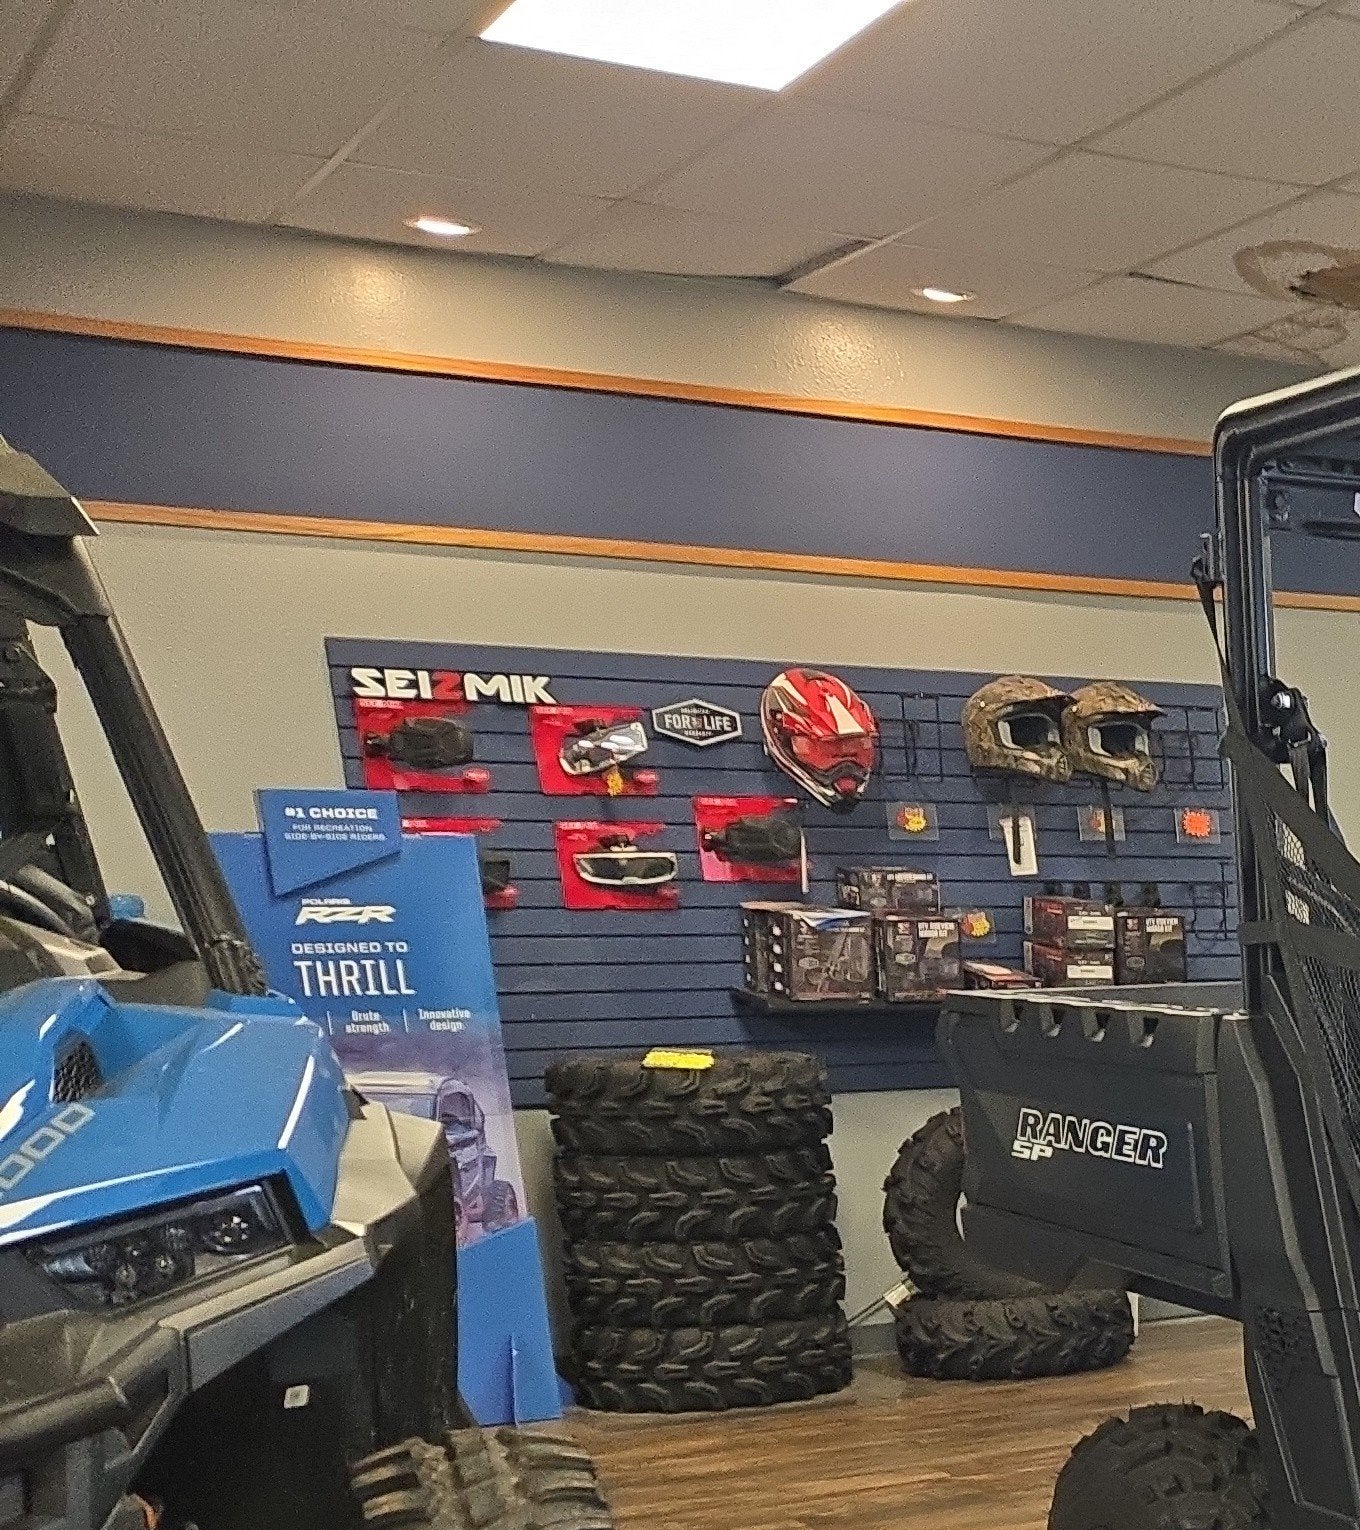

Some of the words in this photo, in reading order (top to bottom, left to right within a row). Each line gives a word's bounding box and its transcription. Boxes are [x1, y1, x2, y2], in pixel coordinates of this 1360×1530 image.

[664, 714, 691, 729] FOR
[703, 715, 732, 731] LIFE
[309, 807, 379, 819] CHOICE
[295, 906, 396, 925] RZR
[291, 942, 381, 955] DESIGNED
[385, 941, 408, 952] TO
[294, 959, 417, 997] THRILL
[351, 1010, 380, 1021] Brute
[418, 1008, 471, 1020] Innovative
[345, 1023, 390, 1035] strength
[429, 1020, 463, 1032] design
[1017, 1108, 1167, 1169] RANGER
[1011, 1140, 1053, 1161] SP
